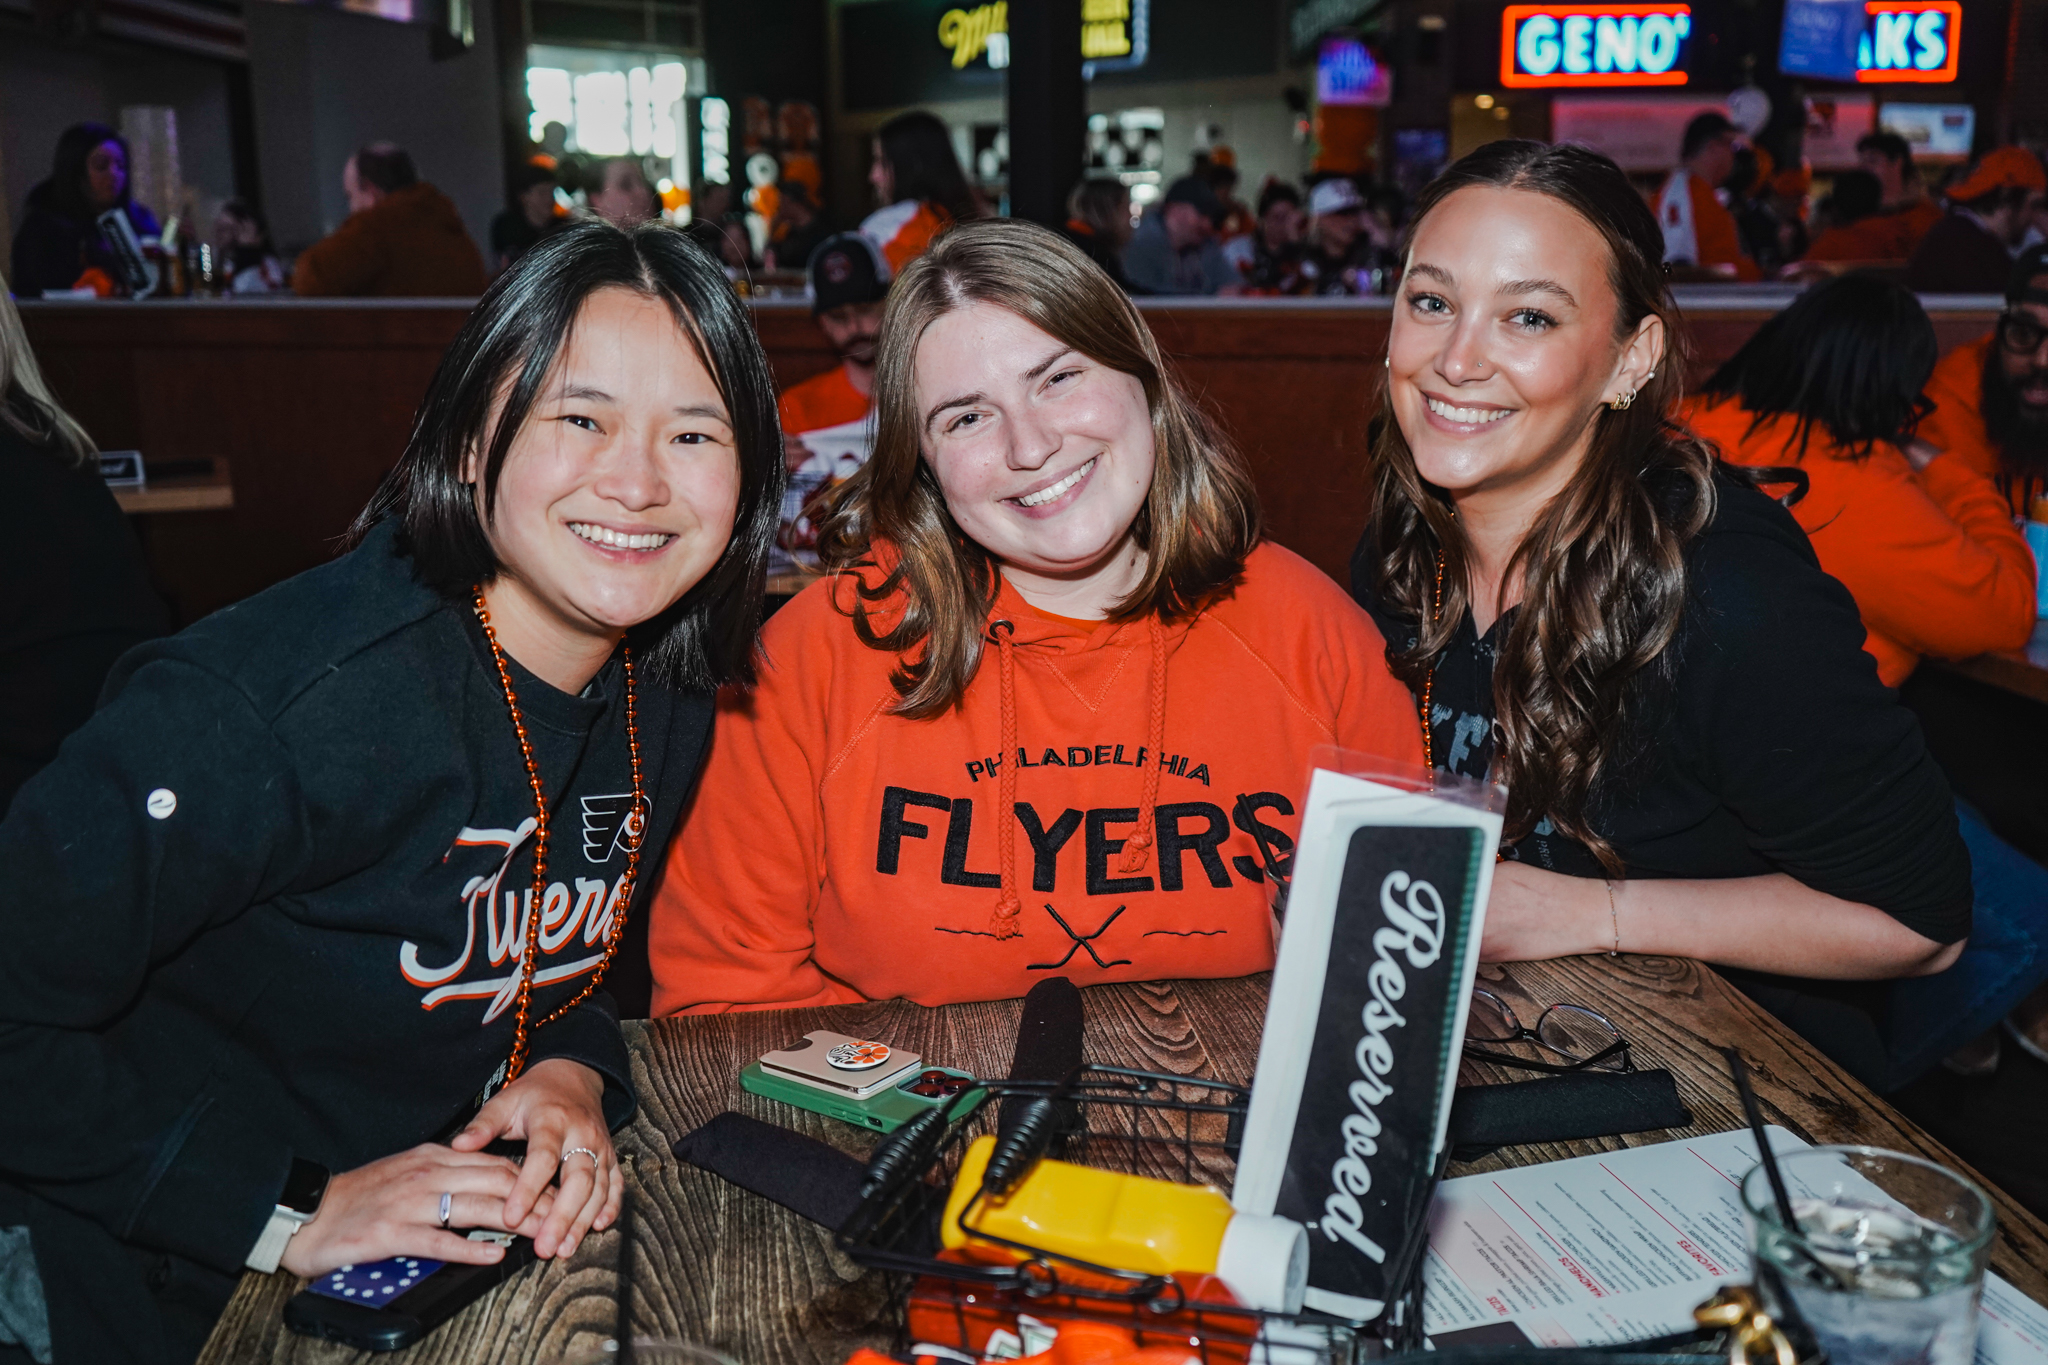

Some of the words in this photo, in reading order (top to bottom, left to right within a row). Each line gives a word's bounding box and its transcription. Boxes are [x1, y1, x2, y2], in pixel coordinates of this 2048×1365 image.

[1517, 13, 1691, 75] GENO'
[1857, 10, 1947, 70] KS
[876, 790, 1297, 896] FLYERS
[1320, 870, 1445, 1264] Reserved
[1556, 1256, 1607, 1298] HANDHELDS
[1675, 1239, 1724, 1276] FAVORITES
[1484, 1295, 1511, 1316] TACOS
